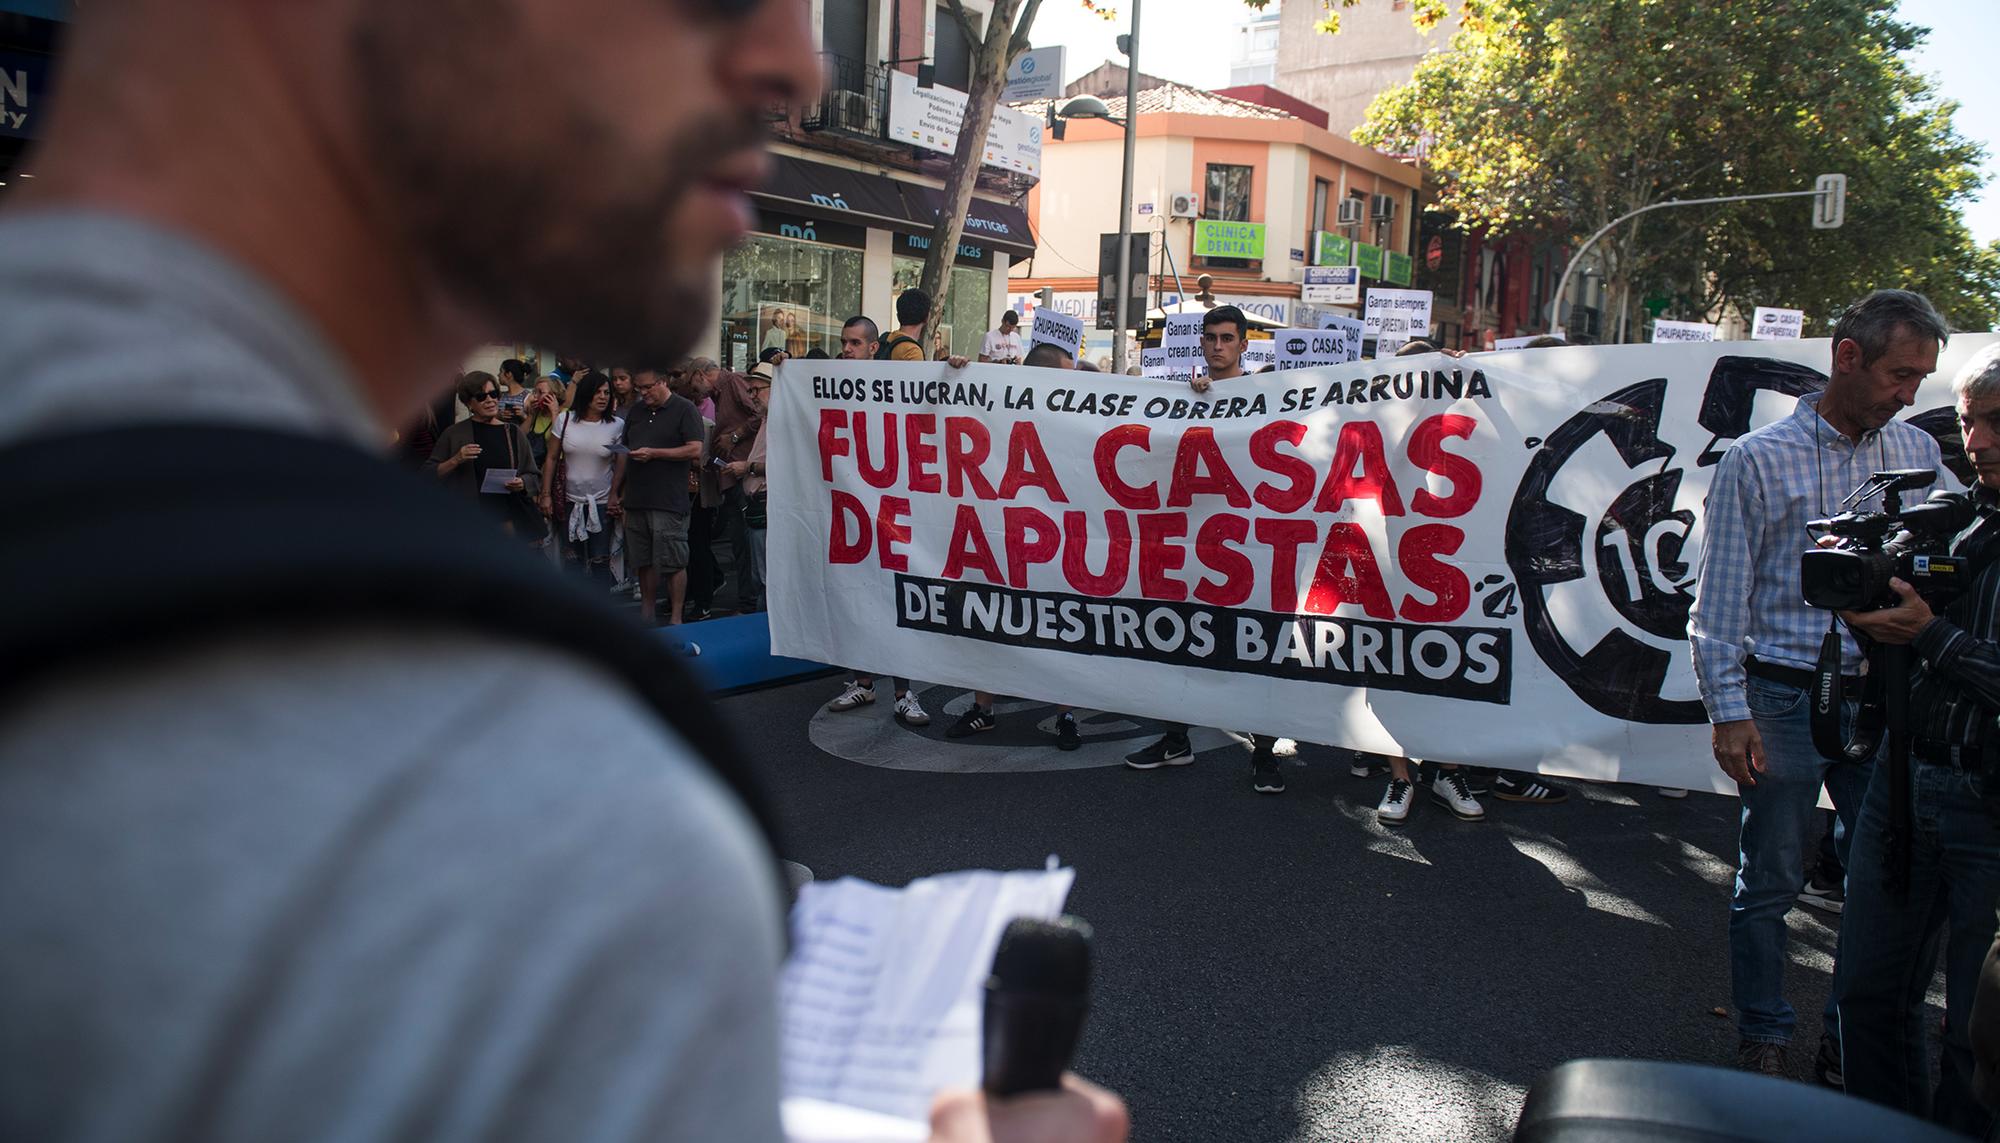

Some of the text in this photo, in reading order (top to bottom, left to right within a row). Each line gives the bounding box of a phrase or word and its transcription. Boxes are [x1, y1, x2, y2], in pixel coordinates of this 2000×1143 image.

[1207, 240, 1253, 254] DENTAL
[1367, 295, 1392, 308] Ganan
[1034, 316, 1079, 345] CHUPAPERRAS
[1167, 321, 1192, 336] Ganan
[1656, 327, 1712, 342] CHUPAPERRAS
[1168, 346, 1190, 358] crean
[1312, 337, 1344, 354] CASAS
[1143, 355, 1165, 368] Ganan
[813, 368, 1492, 419] ELLOS SE LUCRAN, LA CLASE OBRERA SE ARRUINA
[818, 408, 1483, 519] FUERA CASAS
[828, 489, 1471, 623] DE APUESTAS
[903, 581, 1500, 684] DE NUESTROS BARRIOS
[1819, 672, 1833, 714] Canon
